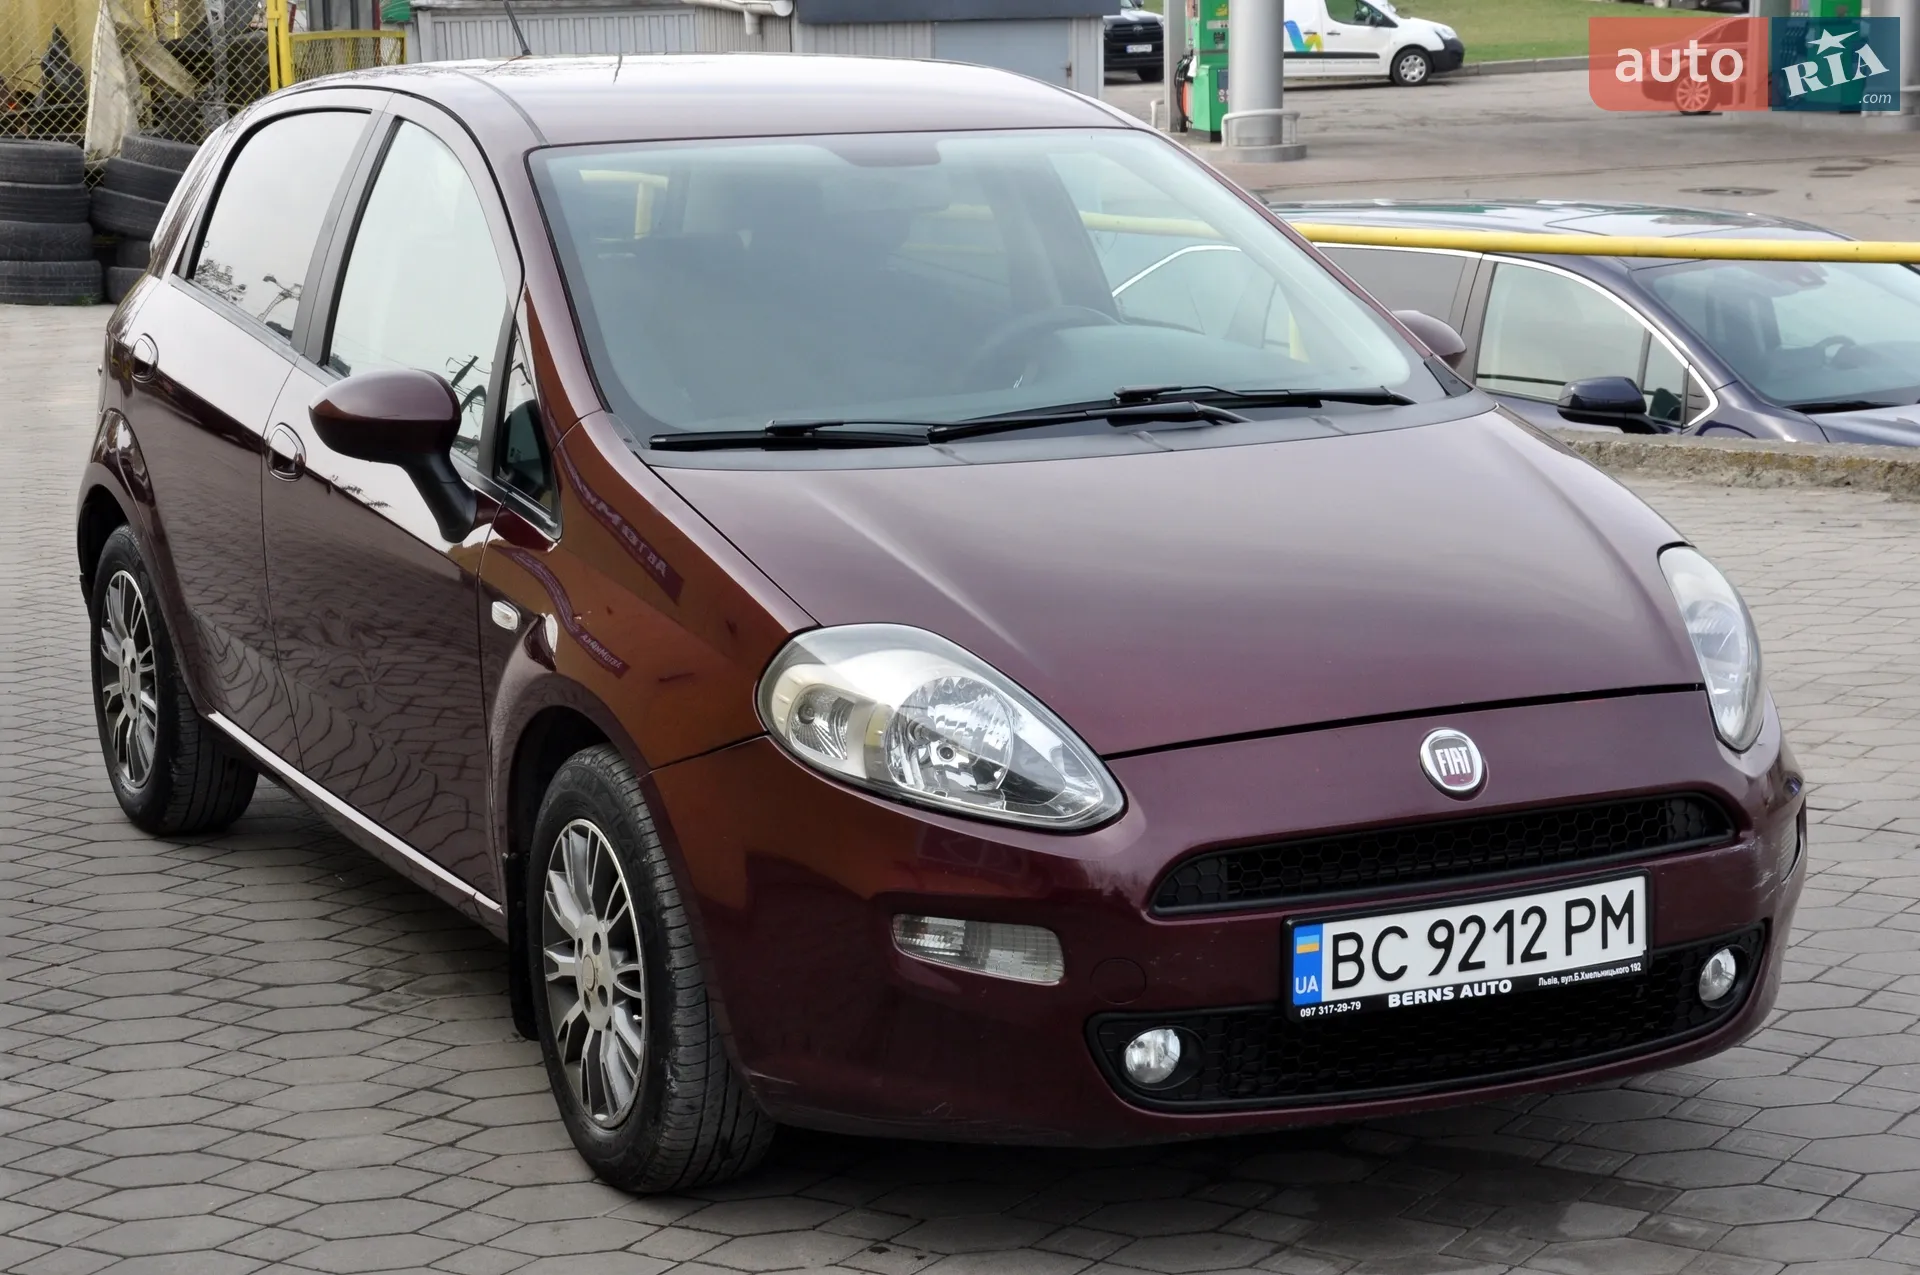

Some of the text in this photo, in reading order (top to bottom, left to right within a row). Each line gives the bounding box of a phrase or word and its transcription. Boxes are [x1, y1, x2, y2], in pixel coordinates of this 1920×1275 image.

[1434, 746, 1472, 777] FIAT
[1331, 889, 1635, 990] BC 9212 PM
[1294, 975, 1319, 995] UA
[1538, 976, 1560, 987] Львів,
[1630, 962, 1642, 972] 192
[1388, 979, 1513, 1009] BERNS AUTO
[1300, 1001, 1362, 1018] 097 317-29-79
